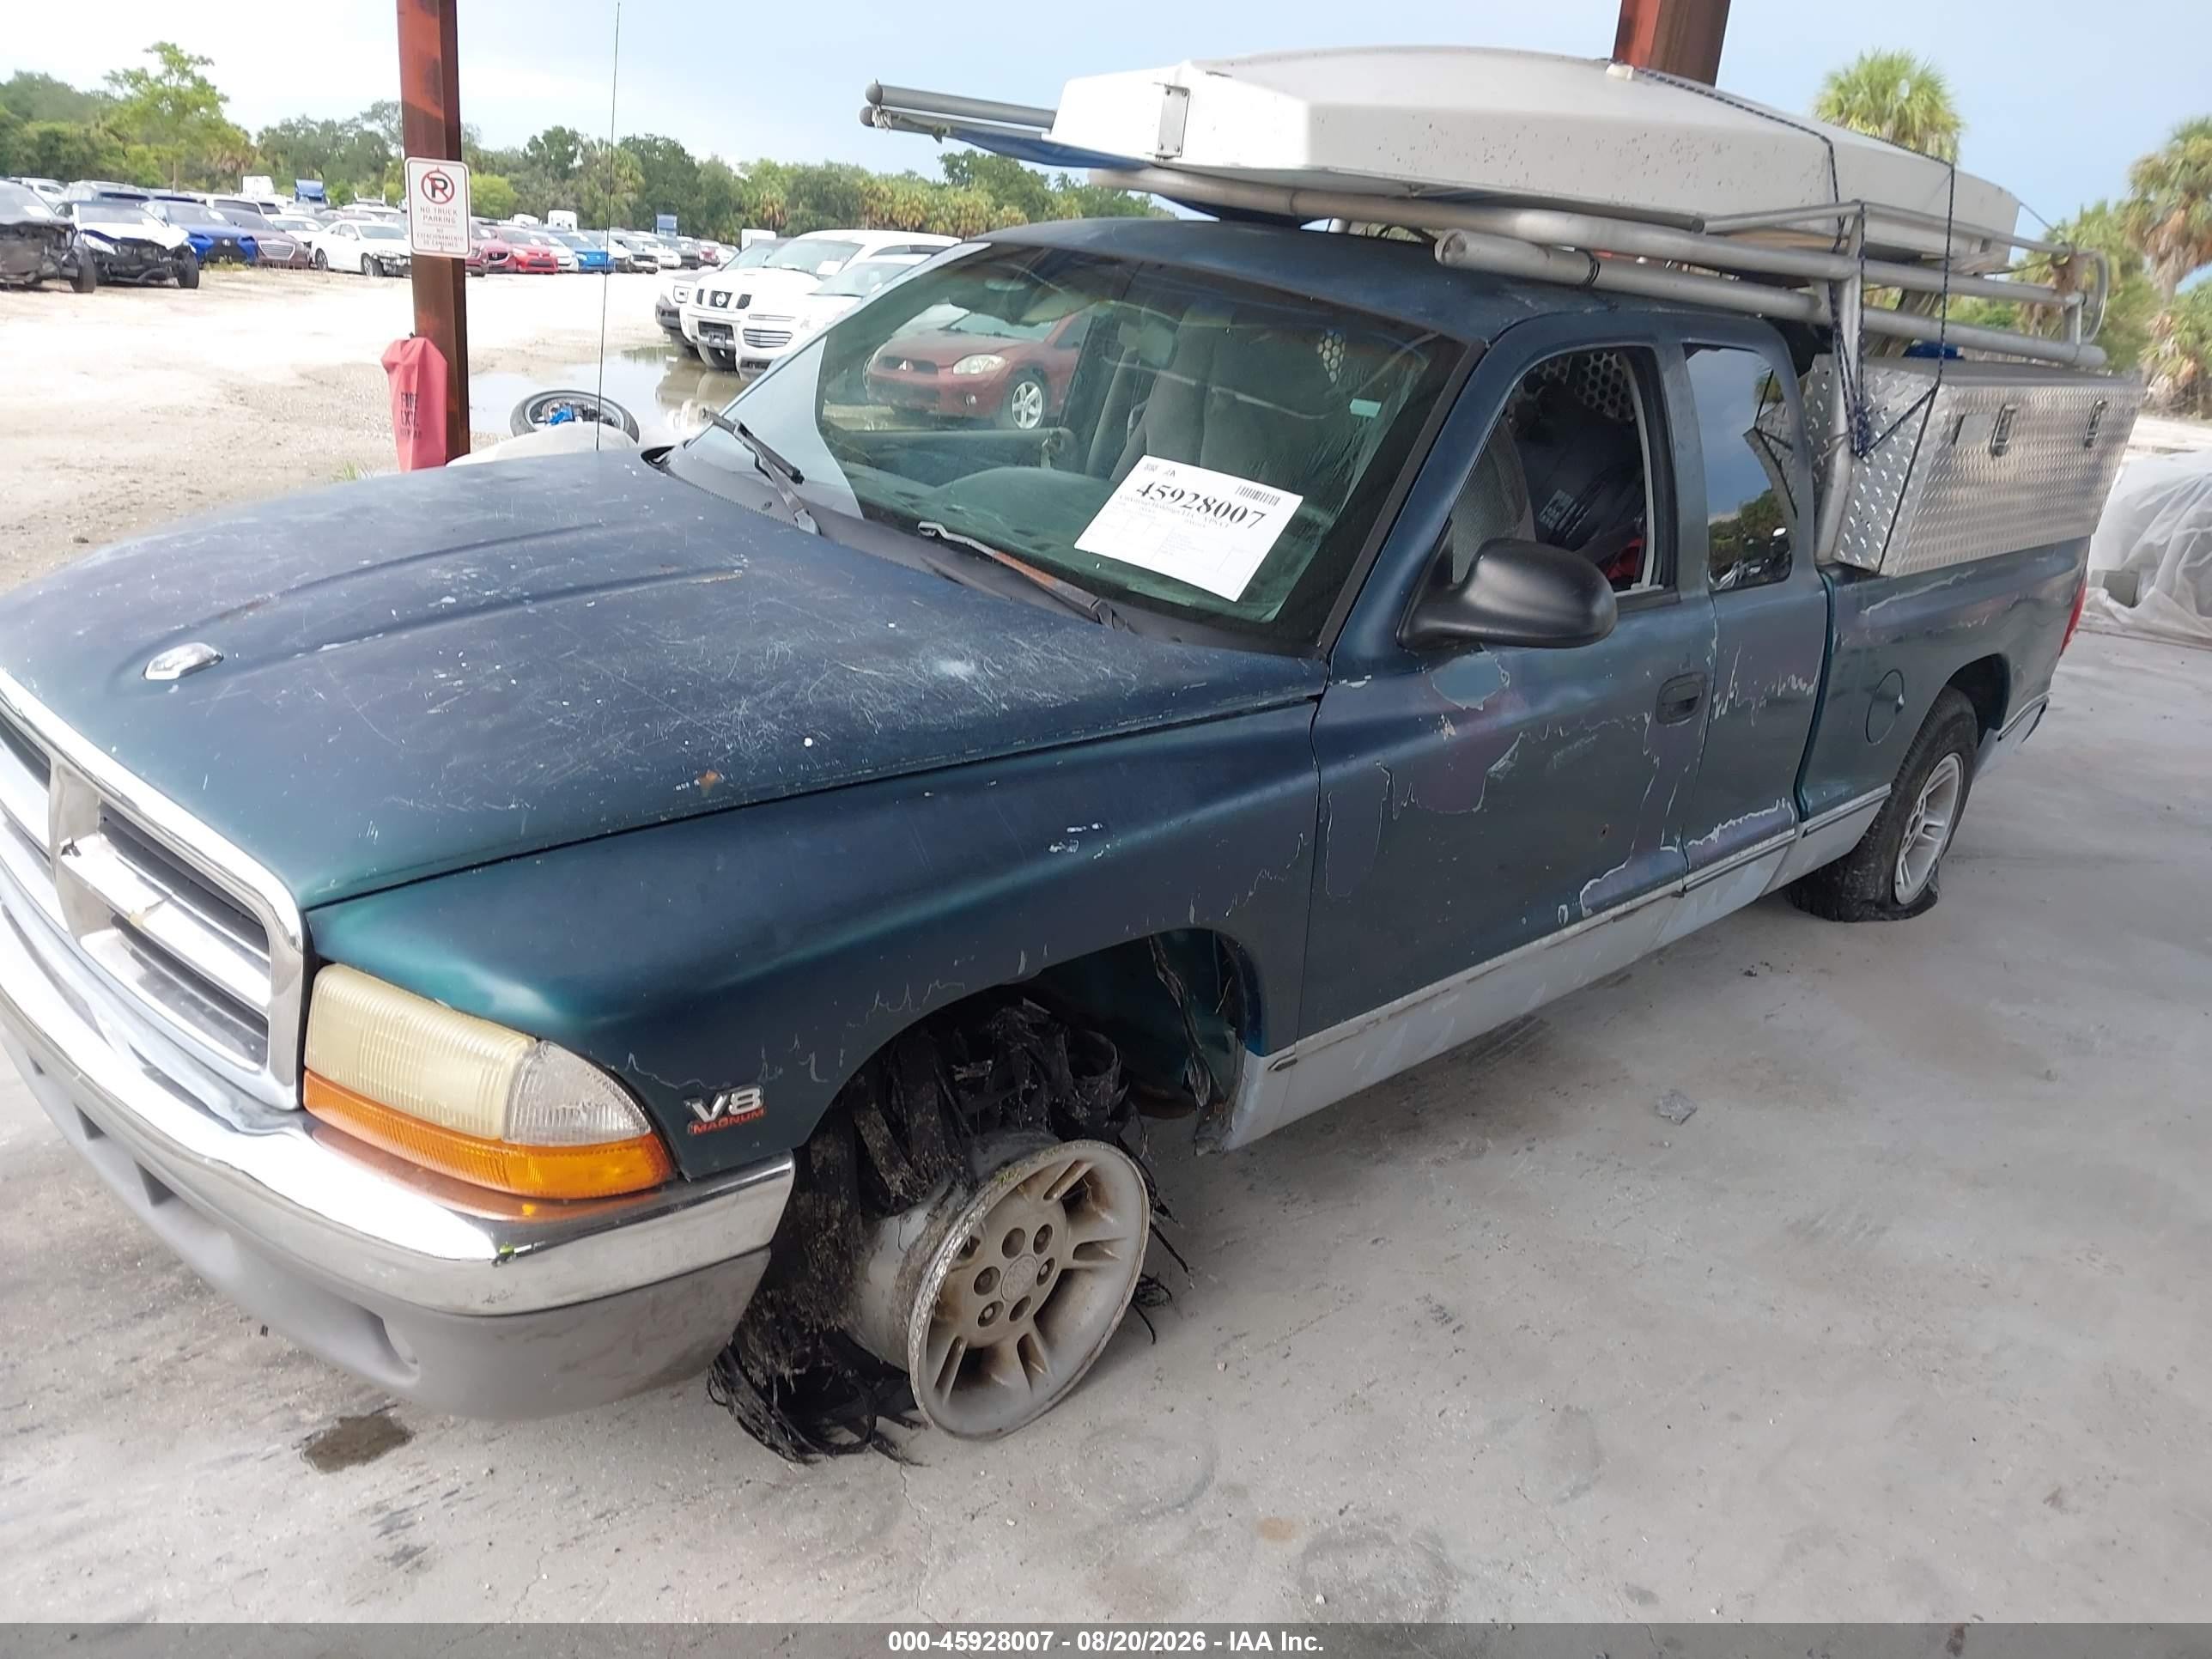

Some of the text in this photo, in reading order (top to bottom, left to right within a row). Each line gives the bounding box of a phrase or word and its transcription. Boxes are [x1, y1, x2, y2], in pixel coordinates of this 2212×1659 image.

[422, 214, 456, 224] PARKING
[434, 207, 459, 216] TRUCK
[1135, 480, 1267, 530] 45928007
[685, 1085, 763, 1123] V8
[690, 1106, 766, 1134] MAGNUM
